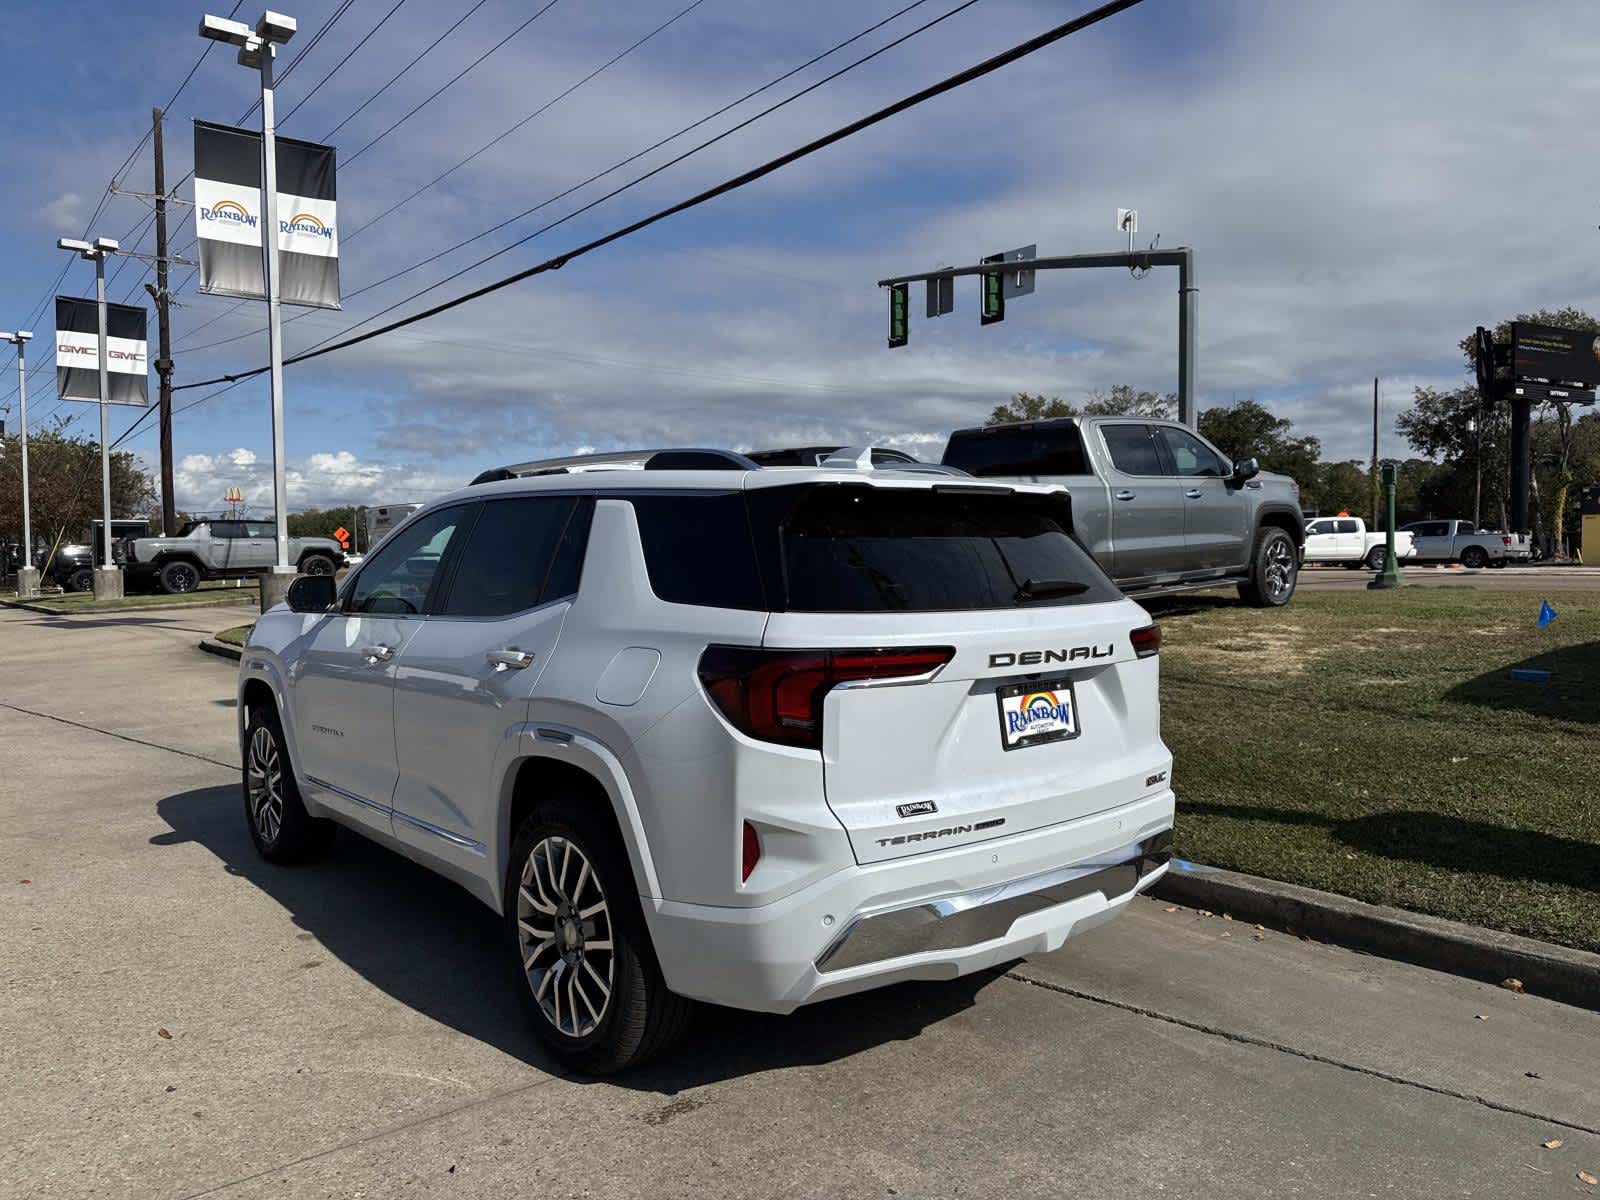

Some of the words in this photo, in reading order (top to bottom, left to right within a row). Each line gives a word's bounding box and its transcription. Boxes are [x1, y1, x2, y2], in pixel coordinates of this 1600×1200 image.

[200, 206, 258, 228] RAINBOW
[279, 220, 333, 240] RAINBOW
[58, 344, 97, 356] GMC
[108, 350, 145, 362] GMC
[988, 643, 1114, 669] DENALI
[1007, 702, 1070, 736] RAINBOW
[900, 801, 934, 817] RAINBOW
[875, 824, 972, 847] TERRAIN
